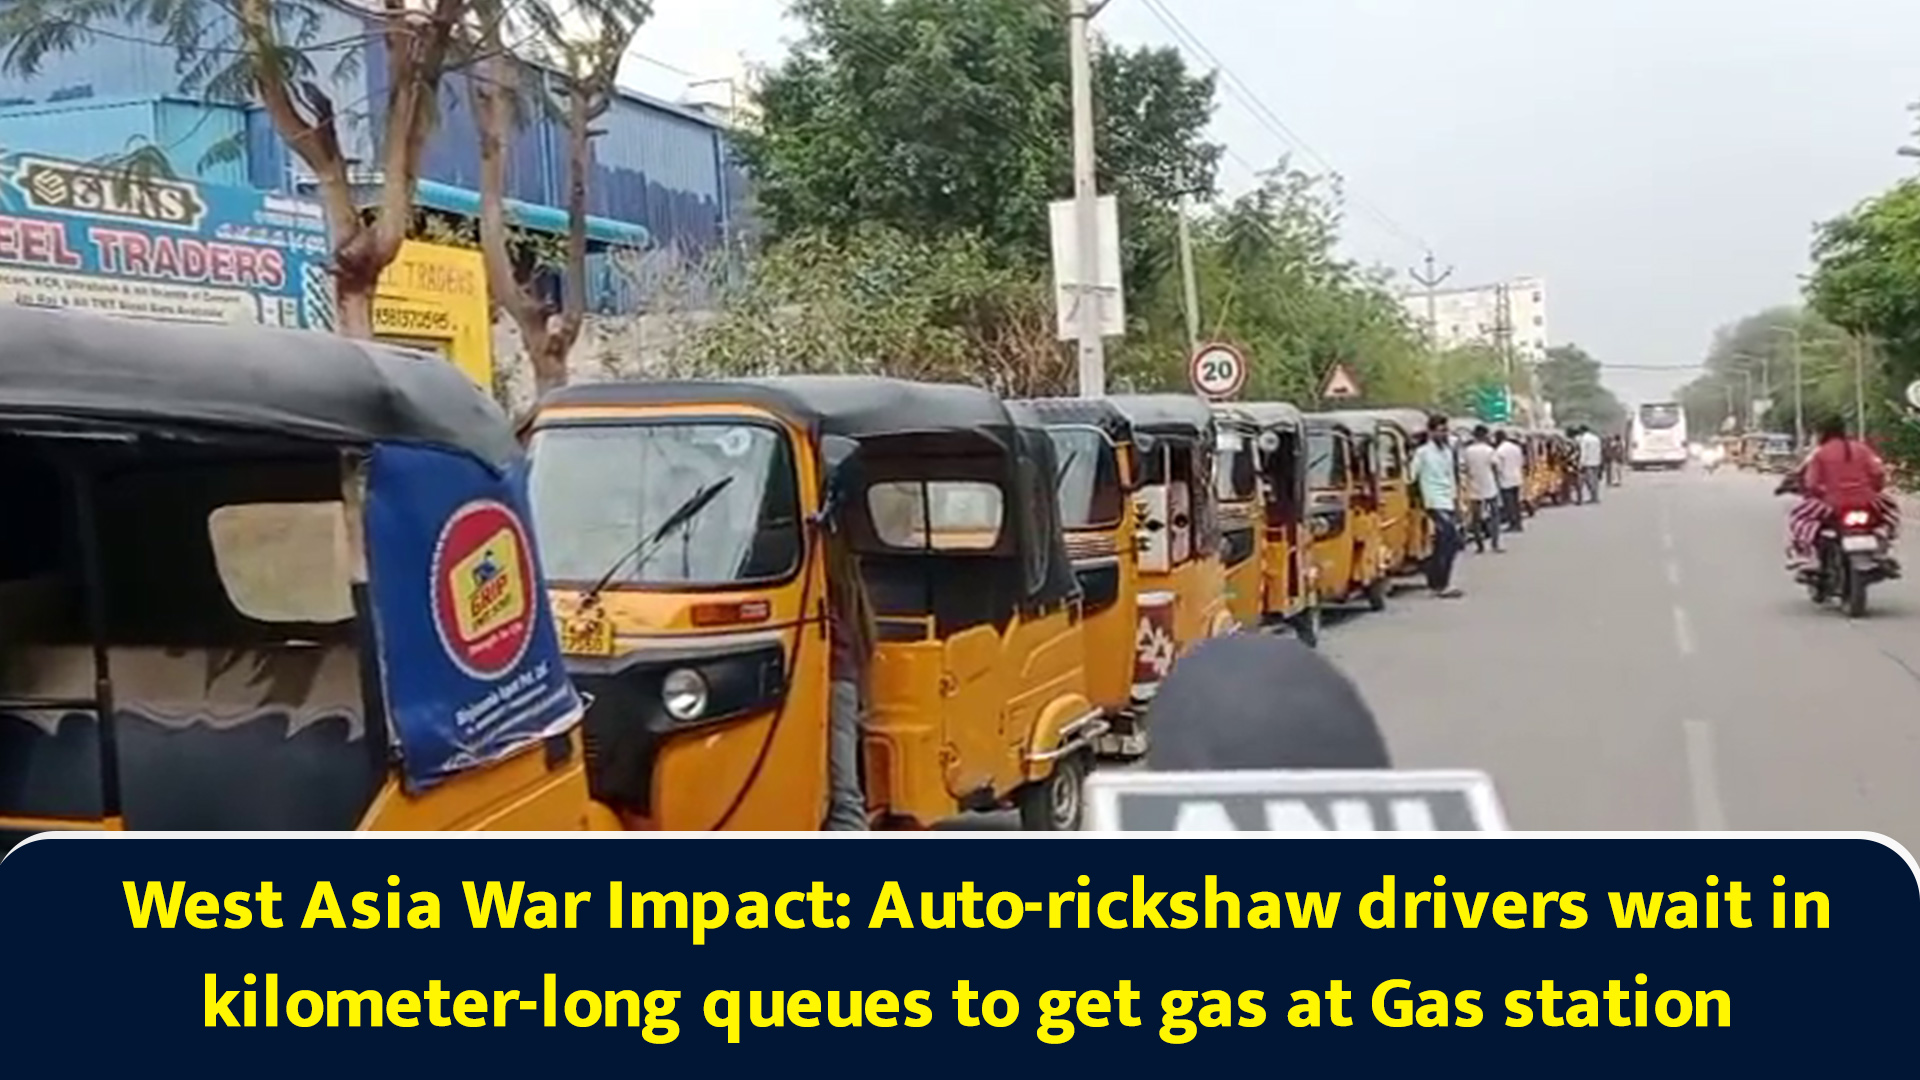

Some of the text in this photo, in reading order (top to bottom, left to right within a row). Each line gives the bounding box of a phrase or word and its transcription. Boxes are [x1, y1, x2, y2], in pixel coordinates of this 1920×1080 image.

[88, 226, 285, 290] TRADERS
[1202, 361, 1234, 381] 20
[471, 573, 508, 617] GRIP
